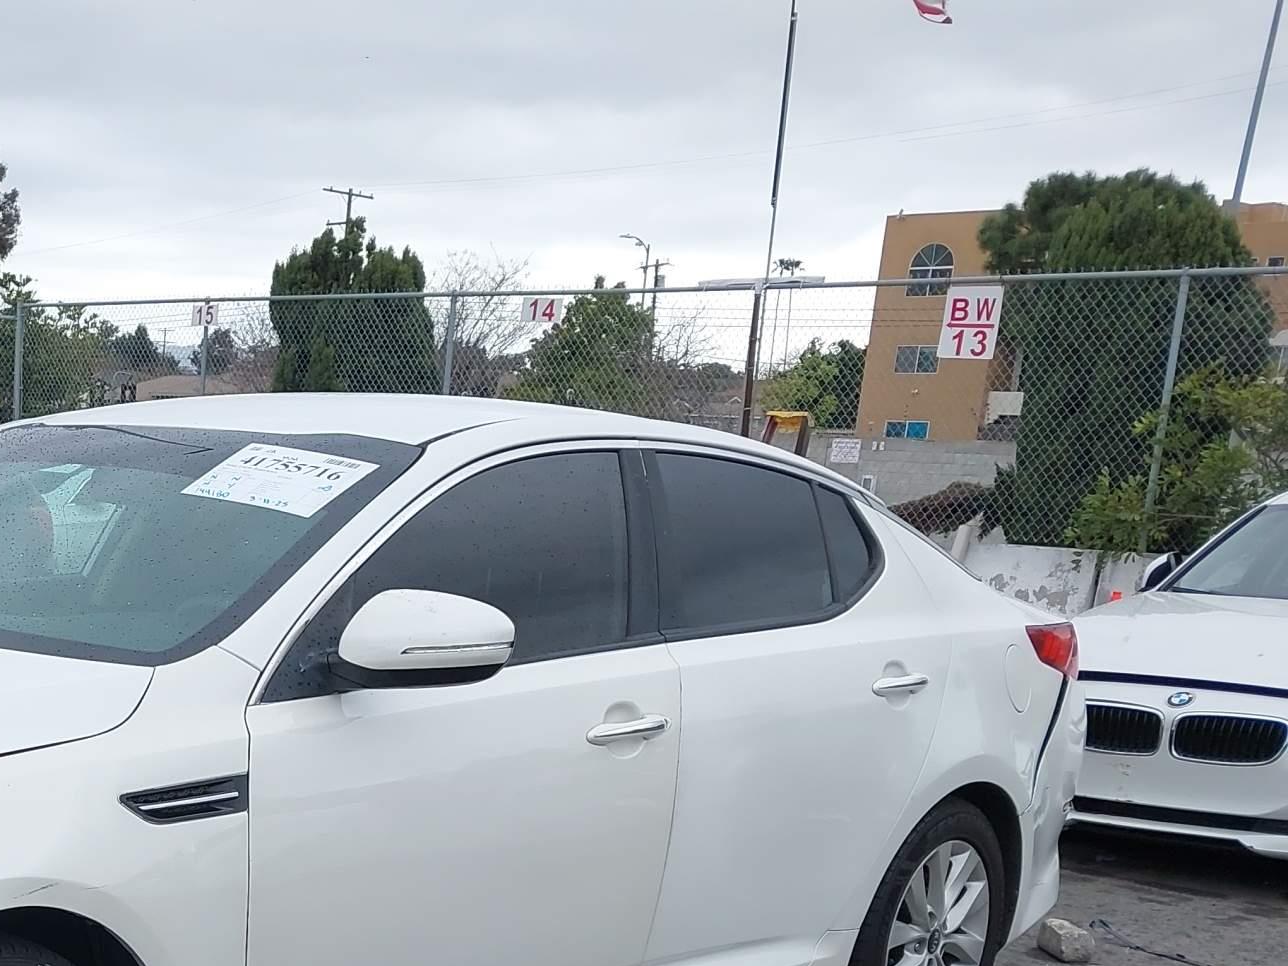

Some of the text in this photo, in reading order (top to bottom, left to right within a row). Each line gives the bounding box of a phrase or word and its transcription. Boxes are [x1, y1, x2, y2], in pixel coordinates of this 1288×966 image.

[196, 305, 213, 325] 15
[529, 298, 556, 321] 14
[951, 297, 997, 322] BW
[952, 329, 988, 357] 13
[240, 455, 347, 481] 41755716
